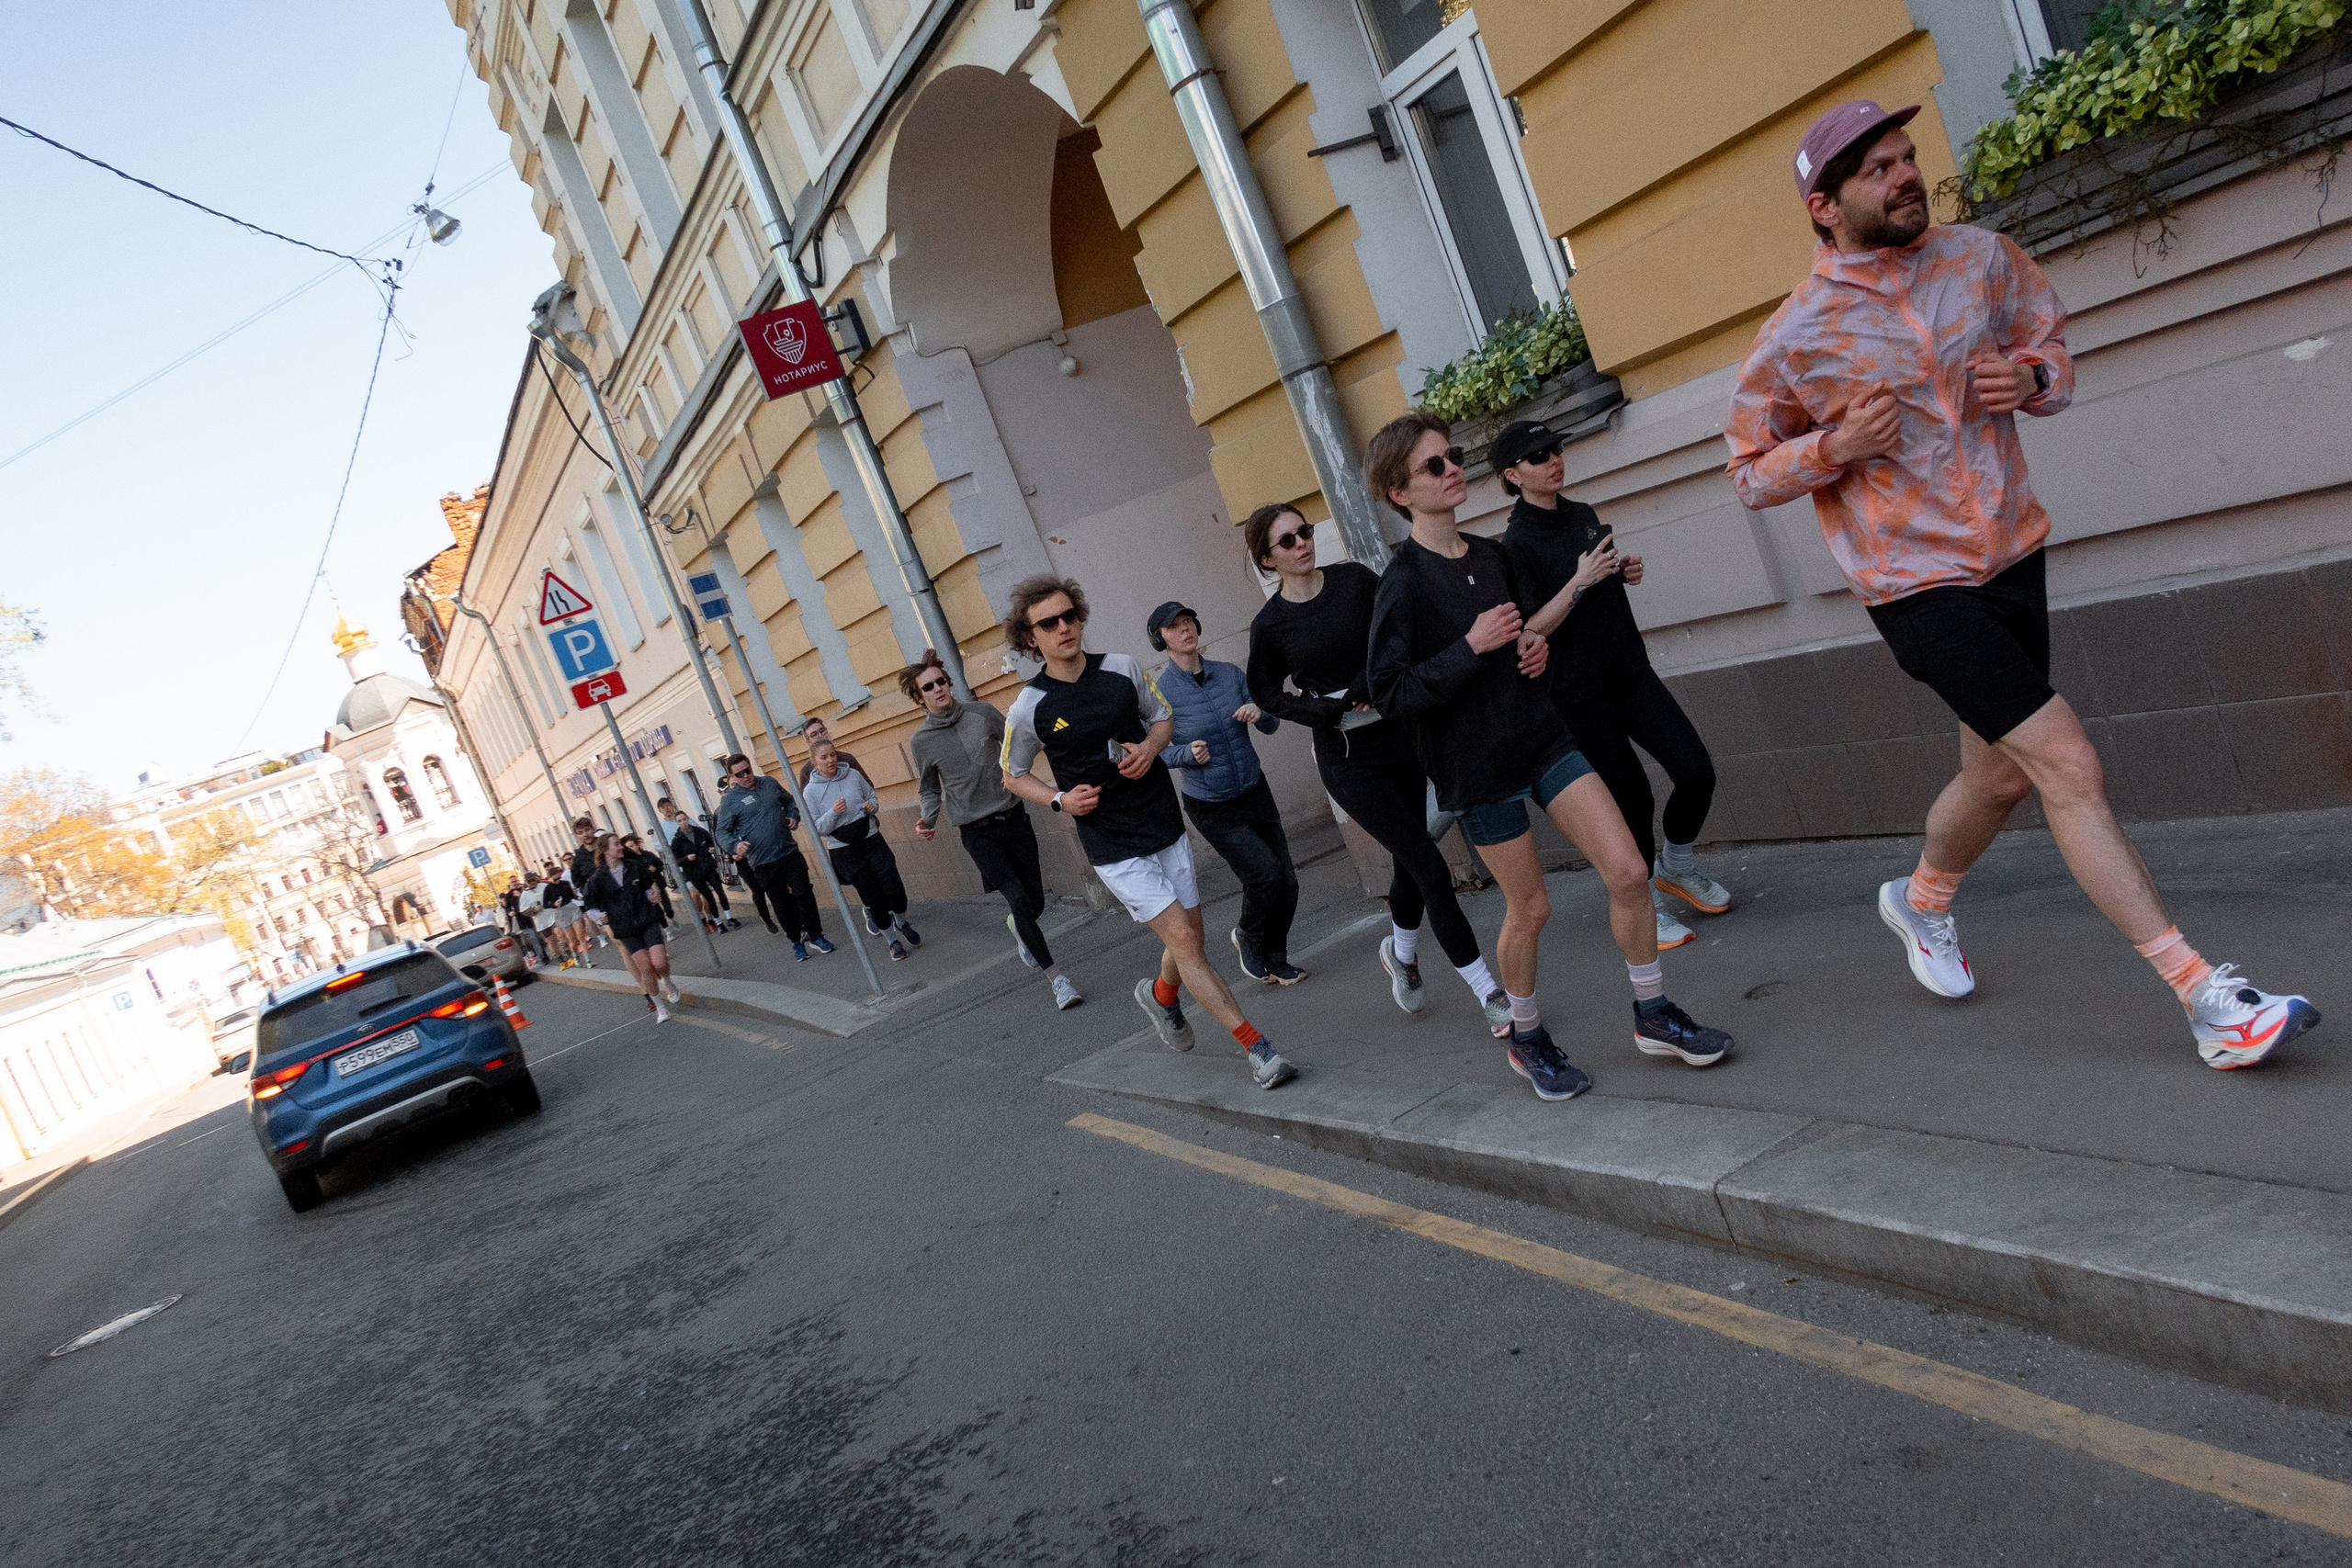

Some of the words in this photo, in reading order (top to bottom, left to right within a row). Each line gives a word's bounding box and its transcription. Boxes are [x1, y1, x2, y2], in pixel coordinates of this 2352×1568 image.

[774, 361, 828, 385] НОТАРИУС
[564, 629, 596, 671] P
[473, 850, 485, 864] P
